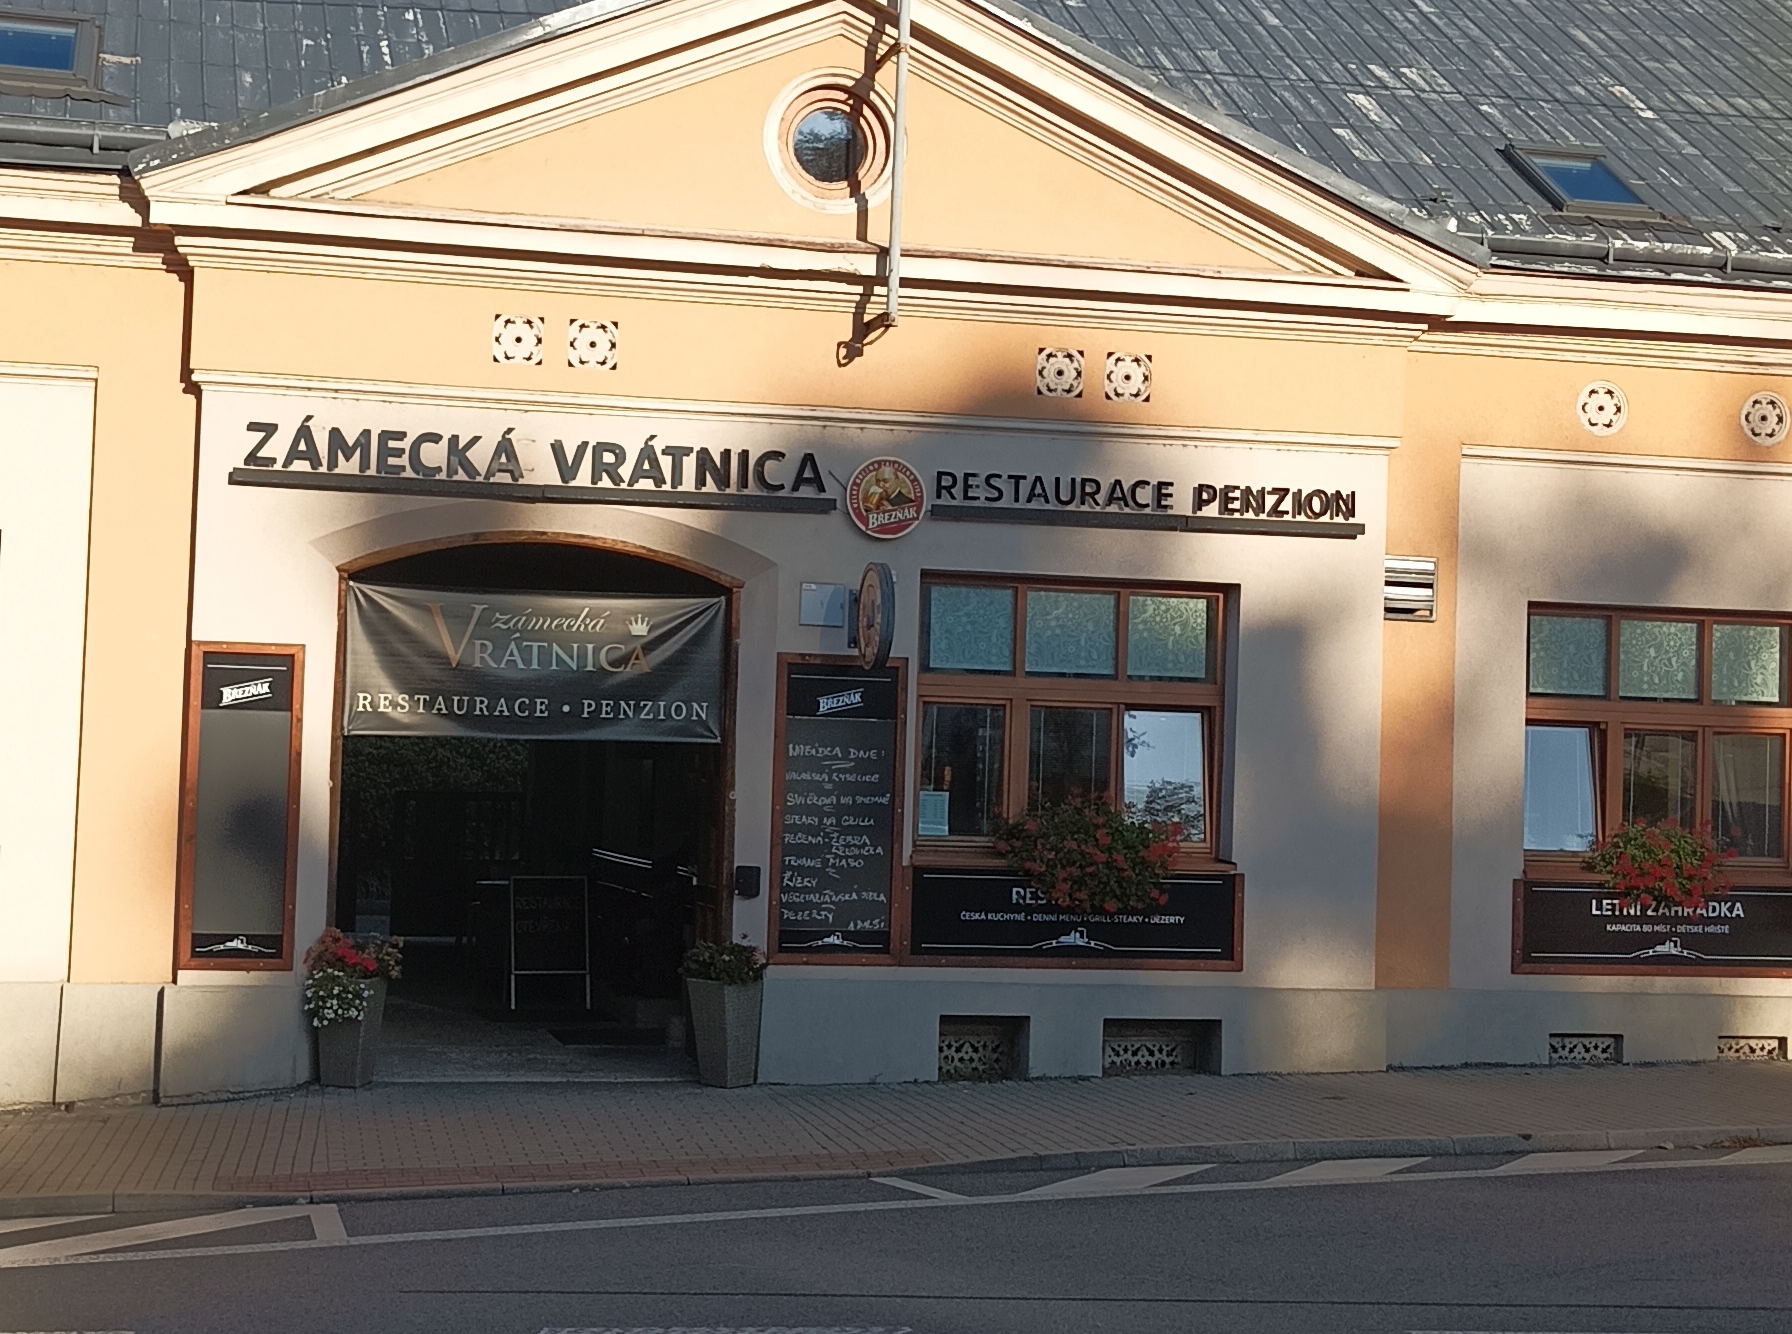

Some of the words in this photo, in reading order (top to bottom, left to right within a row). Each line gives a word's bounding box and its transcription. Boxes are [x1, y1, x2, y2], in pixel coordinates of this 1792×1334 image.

[244, 415, 524, 482] ZÁMECKÁ
[550, 435, 827, 493] VRÁTNICA
[935, 471, 1175, 510] RESTAURACE
[1193, 483, 1357, 521] PENZION
[867, 506, 918, 529] BŘEZŇÁK
[491, 607, 611, 633] zámecká
[424, 603, 653, 673] VRÁTNICA
[356, 692, 550, 717] RESTAURACE
[582, 699, 709, 721] PENZION
[840, 796, 853, 806] NA
[784, 814, 819, 826] STEAKY
[822, 816, 836, 826] NA
[828, 857, 864, 868] MASO
[782, 870, 818, 887] ŘÍZKY
[781, 908, 834, 924] DEZERTY
[960, 910, 986, 920] ČESKÁ
[1032, 912, 1058, 922] DENNÍ
[1059, 913, 1082, 922] MENU
[1150, 914, 1185, 924] DEZERTY
[1646, 898, 1745, 918] ZAHRÁDKA
[1606, 923, 1641, 932] KAPACITA
[1653, 923, 1671, 933] MÍST
